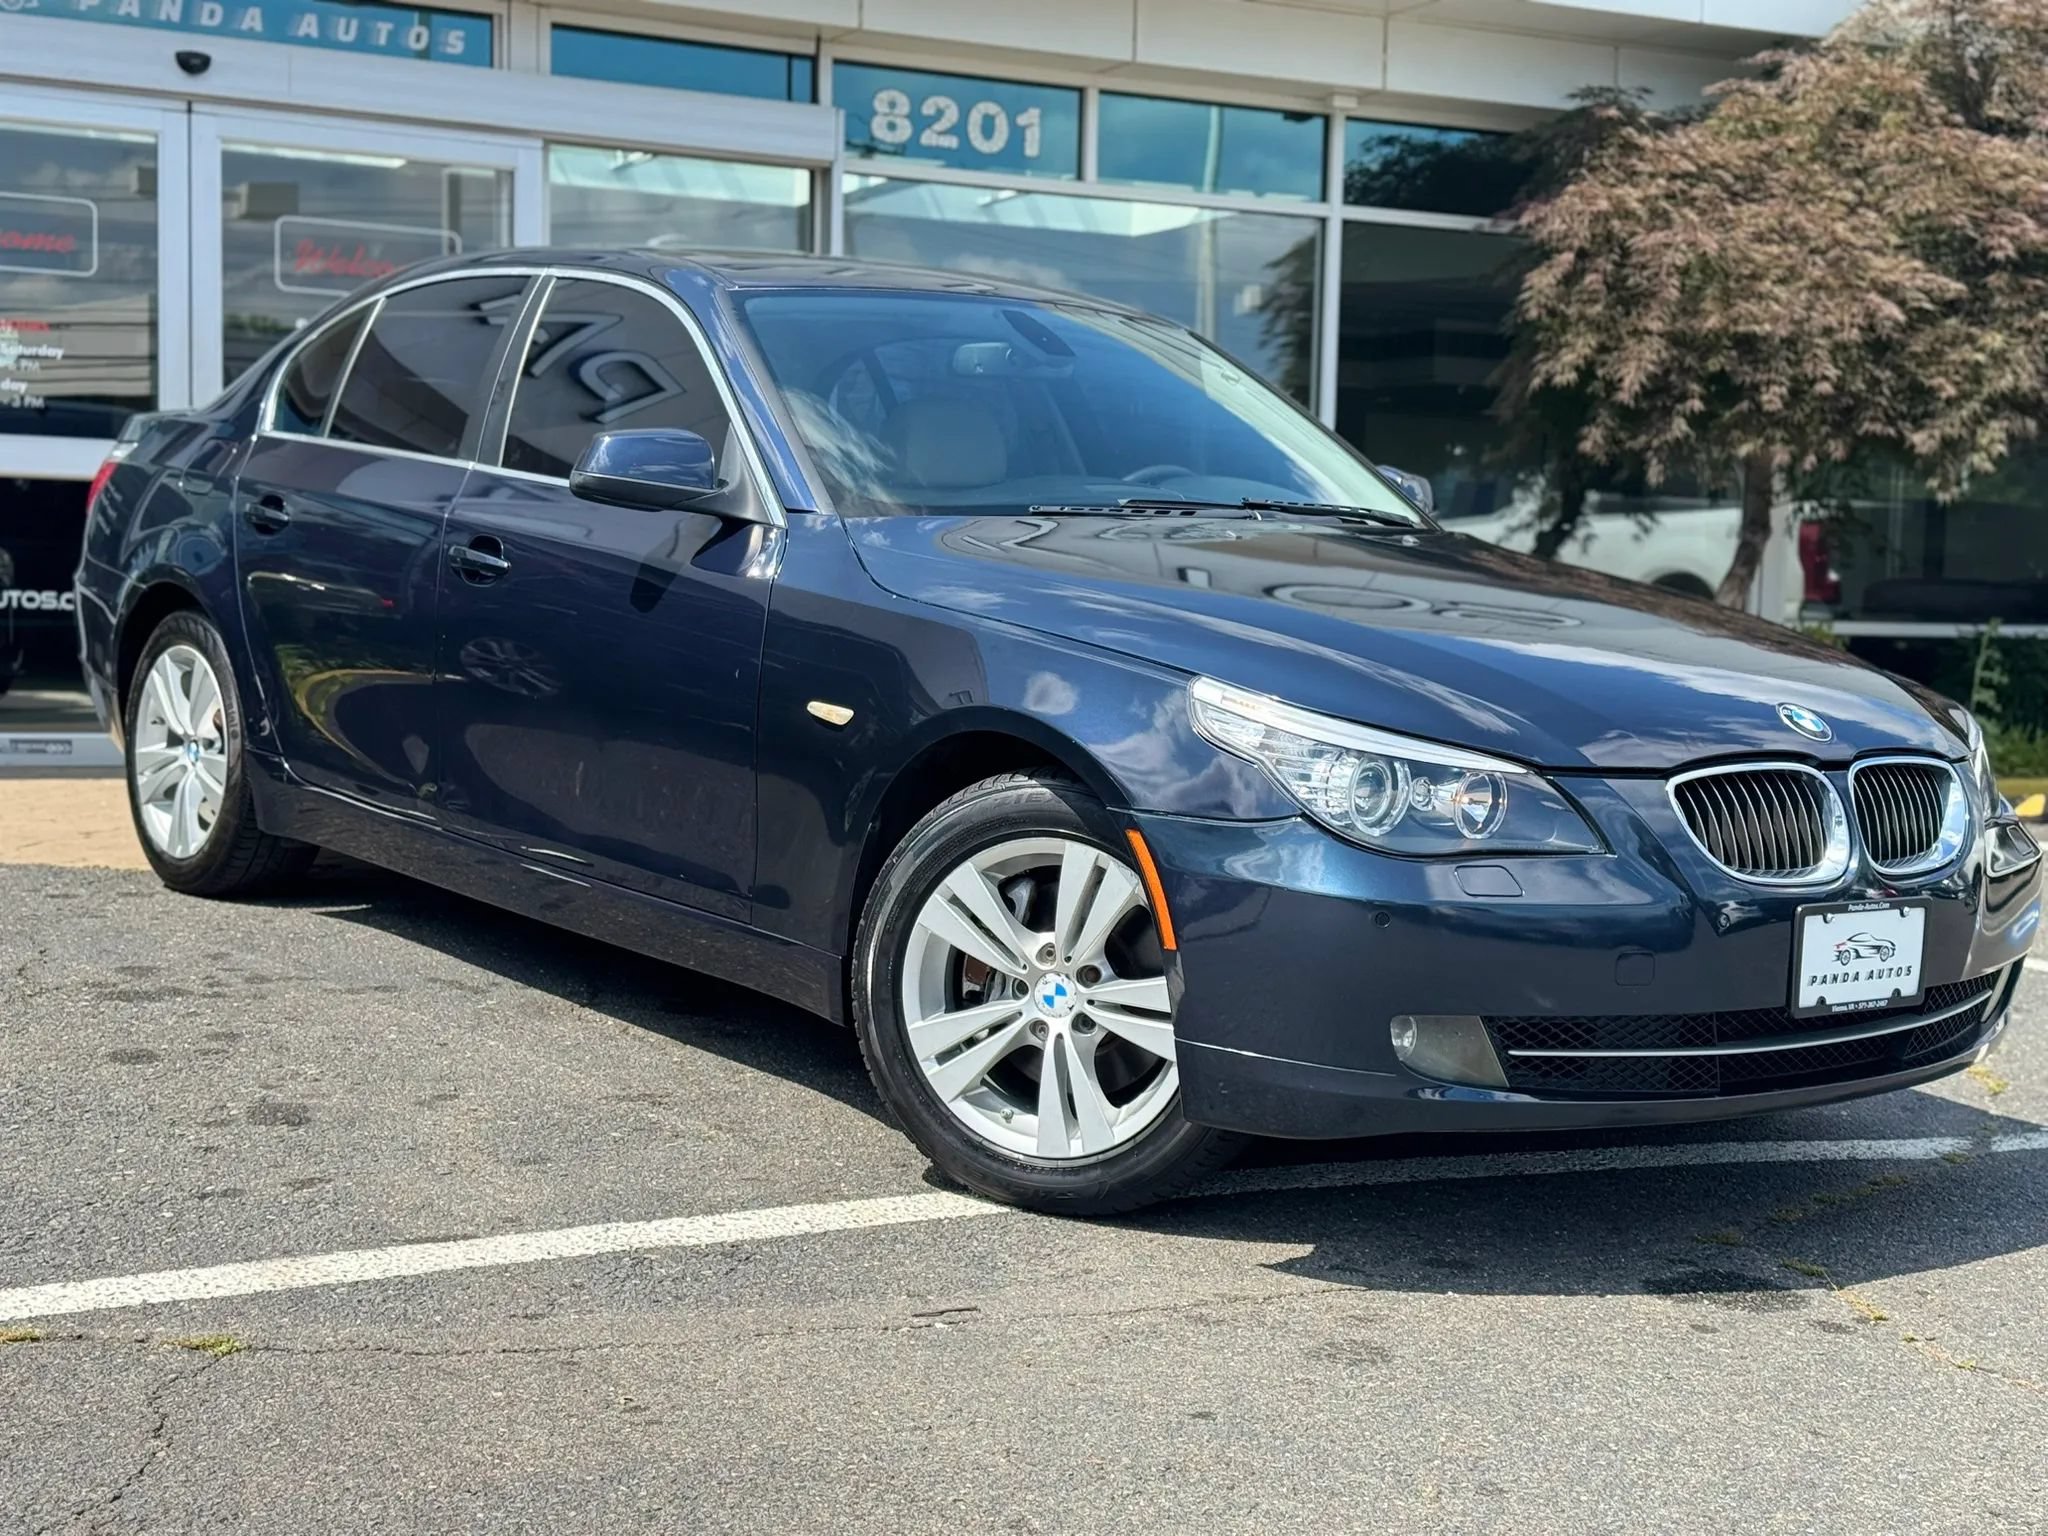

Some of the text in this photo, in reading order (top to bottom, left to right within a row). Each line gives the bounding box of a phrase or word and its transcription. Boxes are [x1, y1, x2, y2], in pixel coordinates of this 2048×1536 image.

[77, 0, 466, 56] PANDA AUTOS
[870, 89, 1042, 158] 8201
[1808, 965, 1912, 986] PANDA AUTOS
